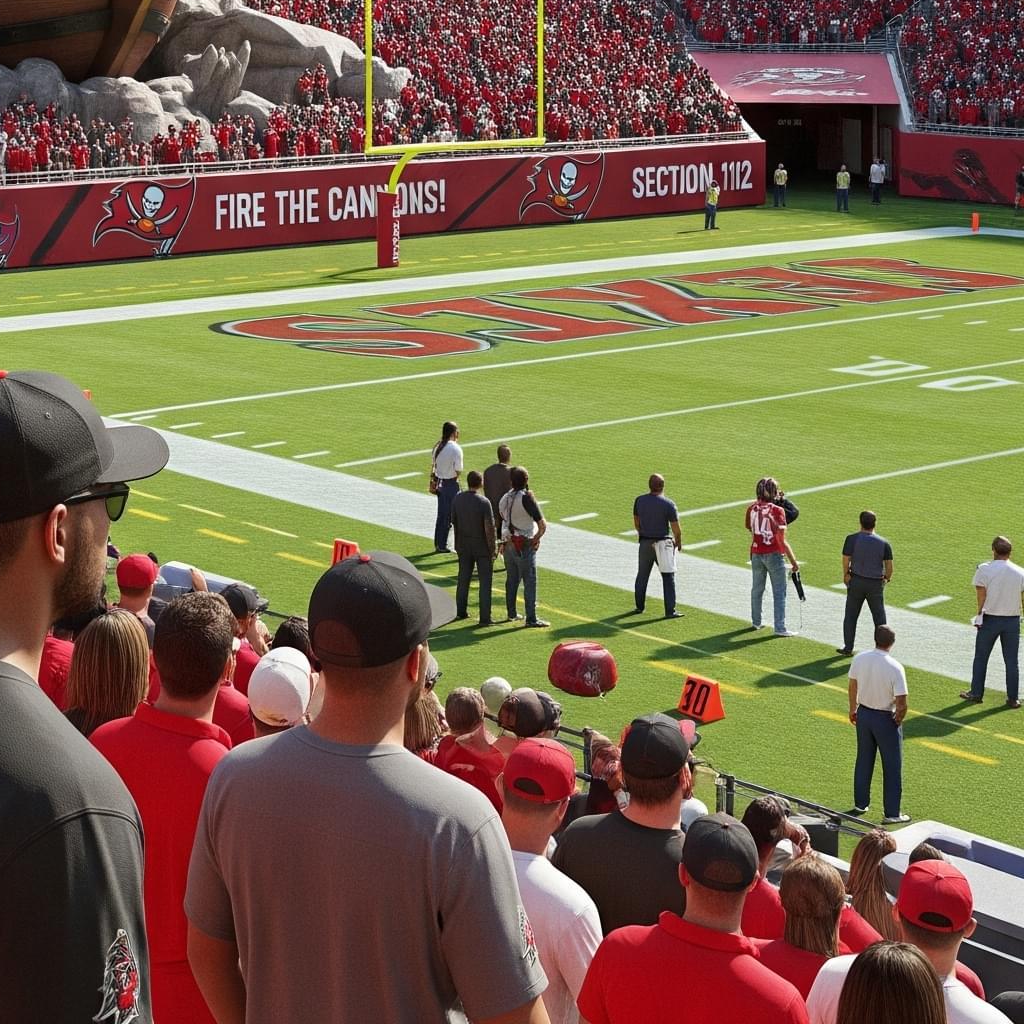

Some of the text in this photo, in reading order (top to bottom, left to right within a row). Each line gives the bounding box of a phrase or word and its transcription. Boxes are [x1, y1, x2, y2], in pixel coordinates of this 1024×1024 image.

[632, 163, 714, 199] SECTION
[215, 179, 446, 230] FIRE THE CANONS!
